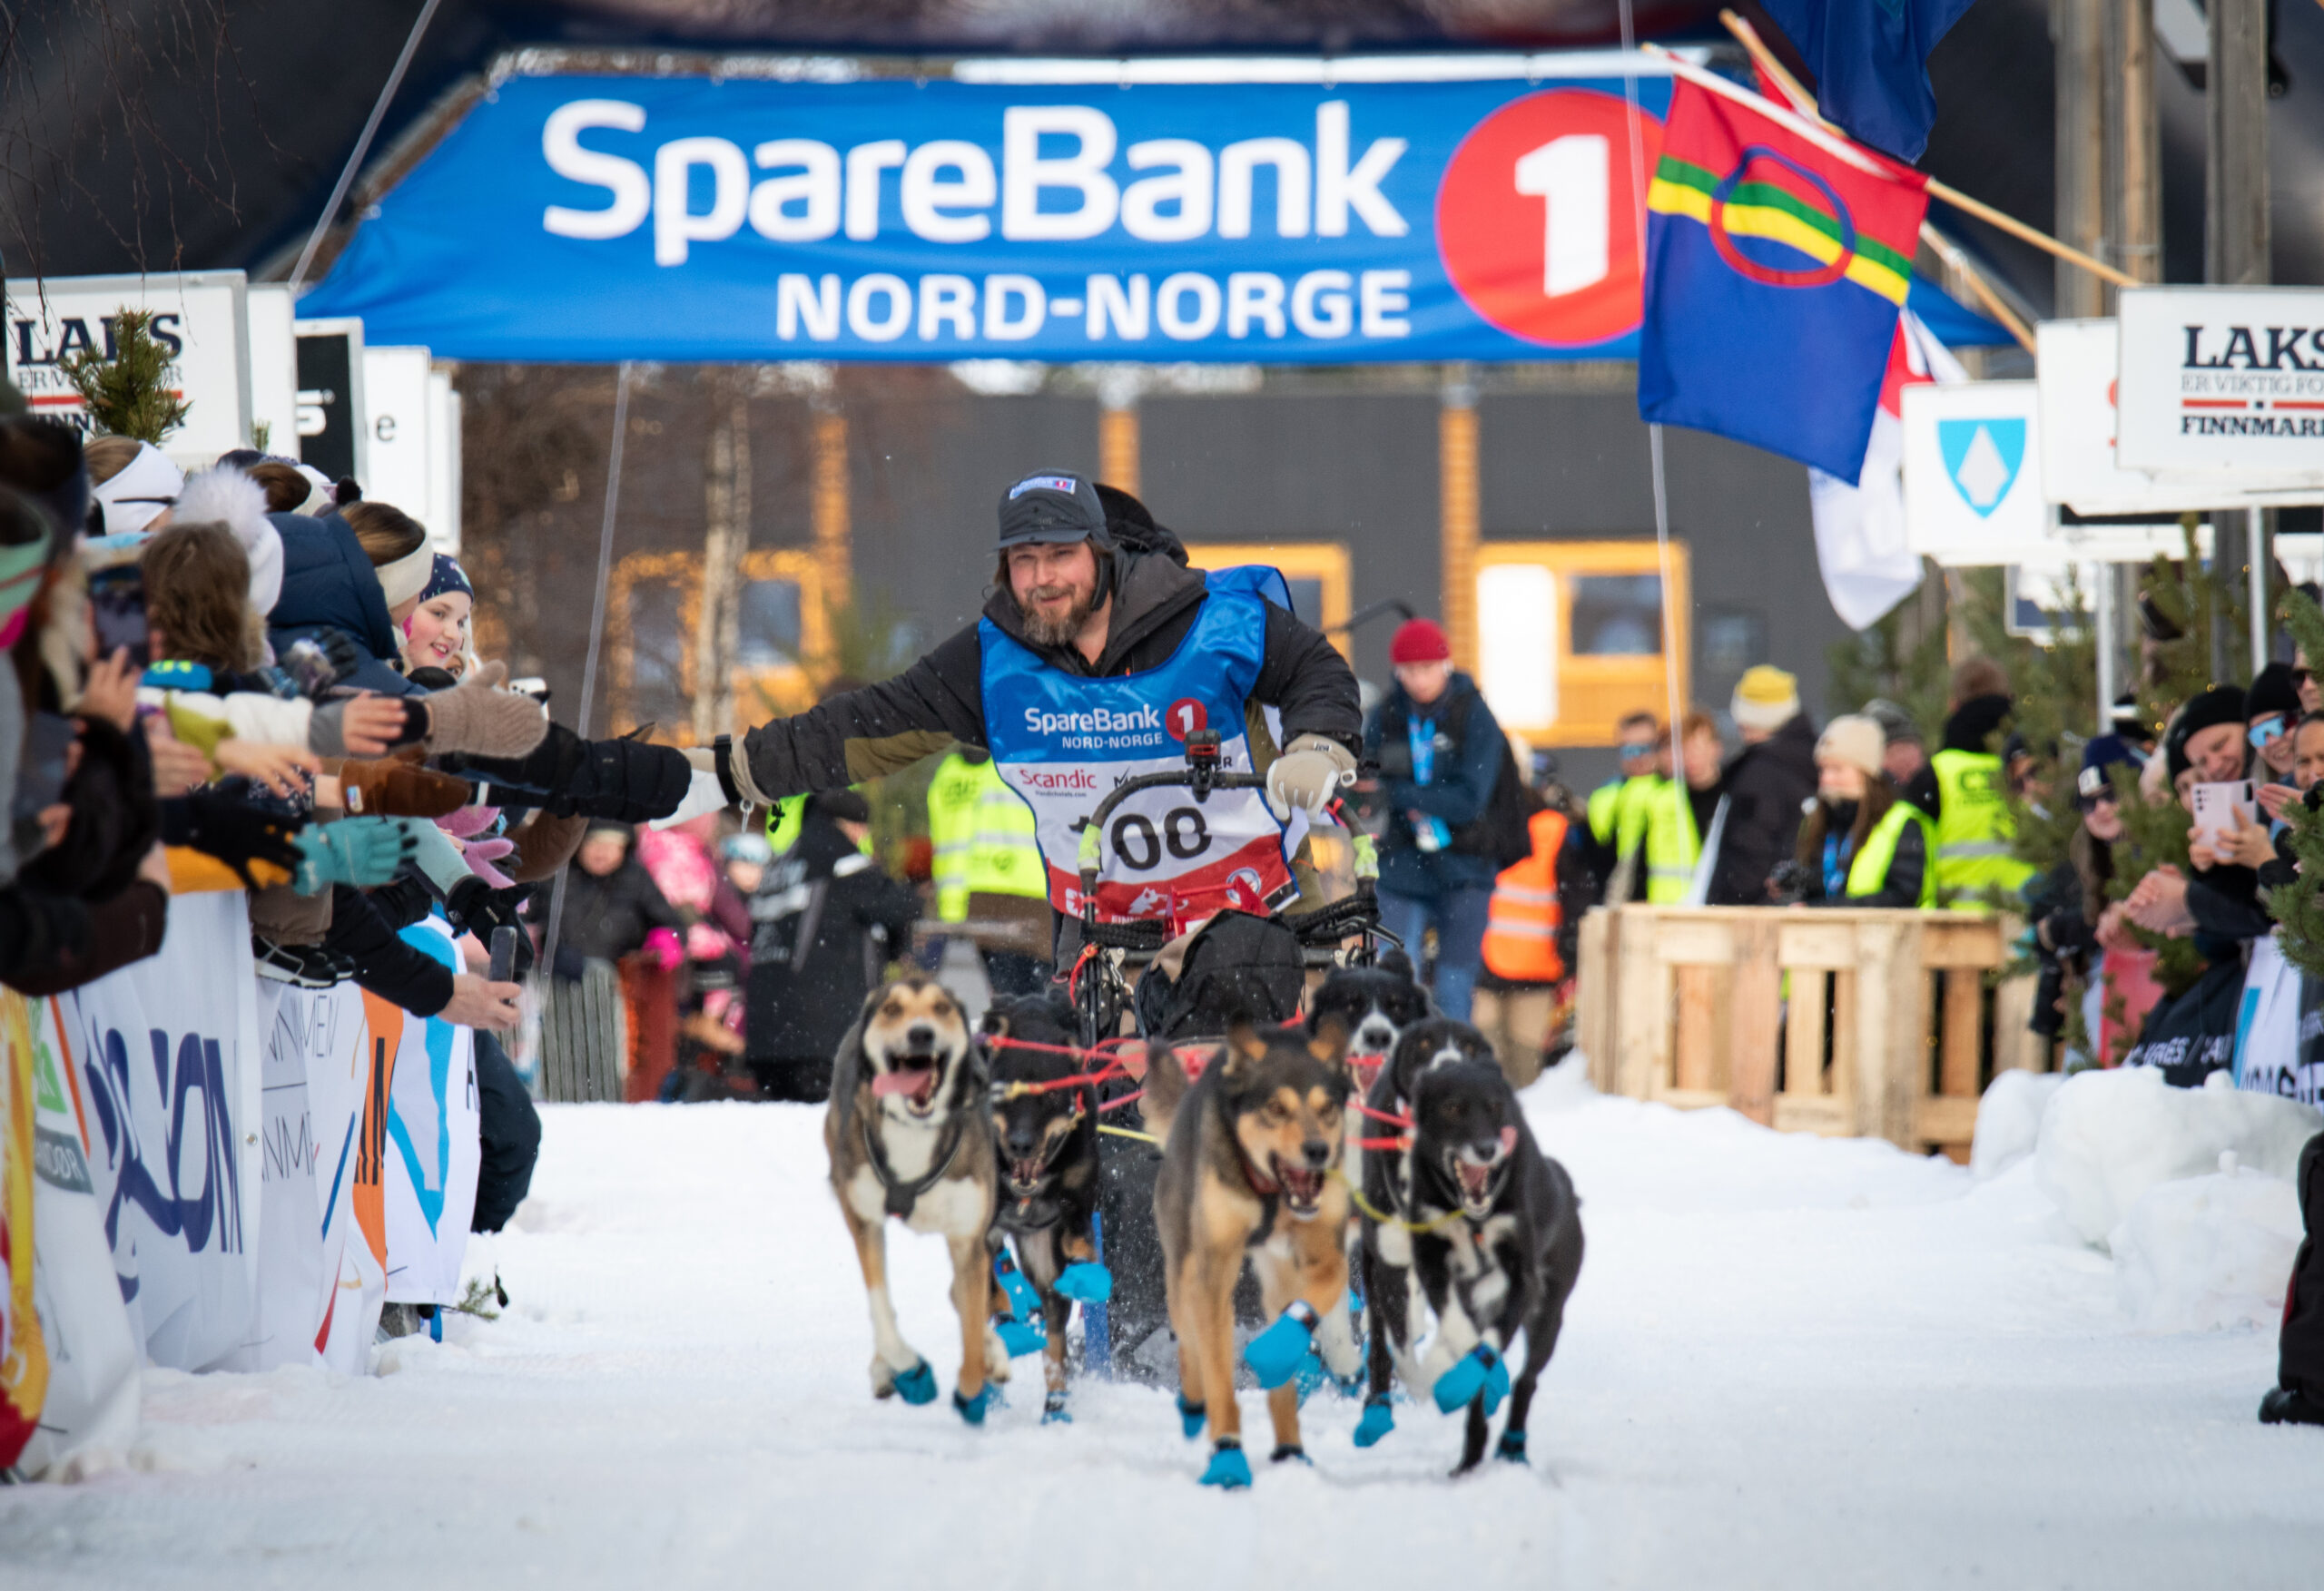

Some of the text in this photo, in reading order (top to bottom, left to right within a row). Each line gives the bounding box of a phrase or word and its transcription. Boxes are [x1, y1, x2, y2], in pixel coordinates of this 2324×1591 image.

[542, 97, 1610, 299] SpareBank 1
[776, 270, 1412, 342] NORD-NORGE
[2181, 373, 2324, 395] ER VIKTIG FO
[2181, 414, 2324, 437] FINNMAR
[1024, 703, 1195, 735] SpareBank 1
[1062, 732, 1163, 749] NORD-NORGE
[1019, 769, 1097, 789] Scandic
